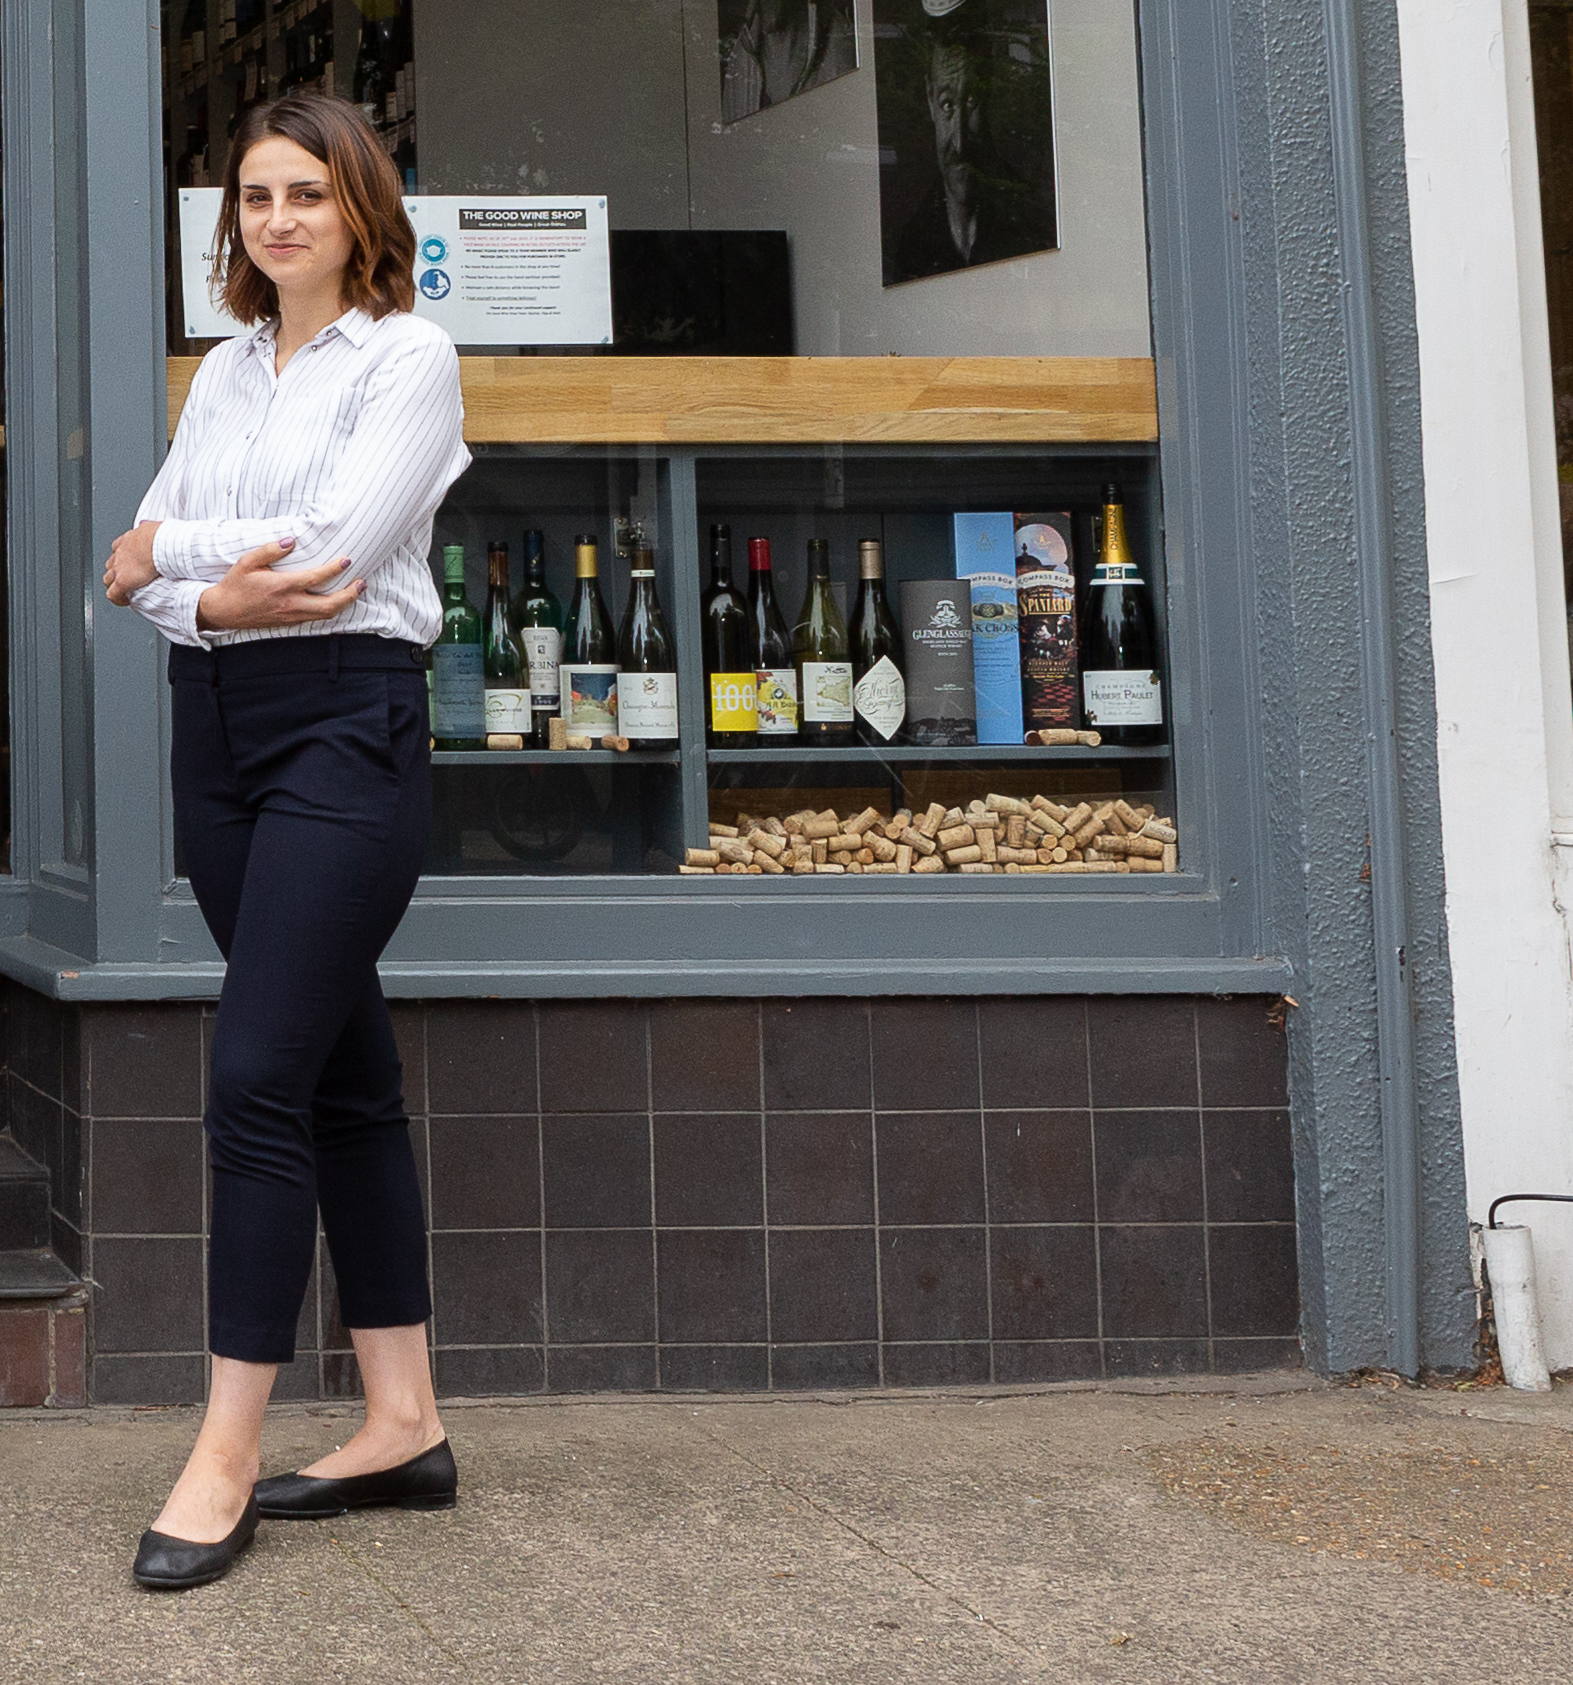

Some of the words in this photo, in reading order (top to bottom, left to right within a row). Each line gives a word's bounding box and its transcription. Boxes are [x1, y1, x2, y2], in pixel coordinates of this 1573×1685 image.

[463, 211, 484, 220] THE
[485, 211, 519, 220] GOOD
[520, 211, 550, 220] WINE
[551, 210, 583, 220] SHOP
[1018, 592, 1072, 617] SPANIARD
[1123, 689, 1153, 699] PAULET
